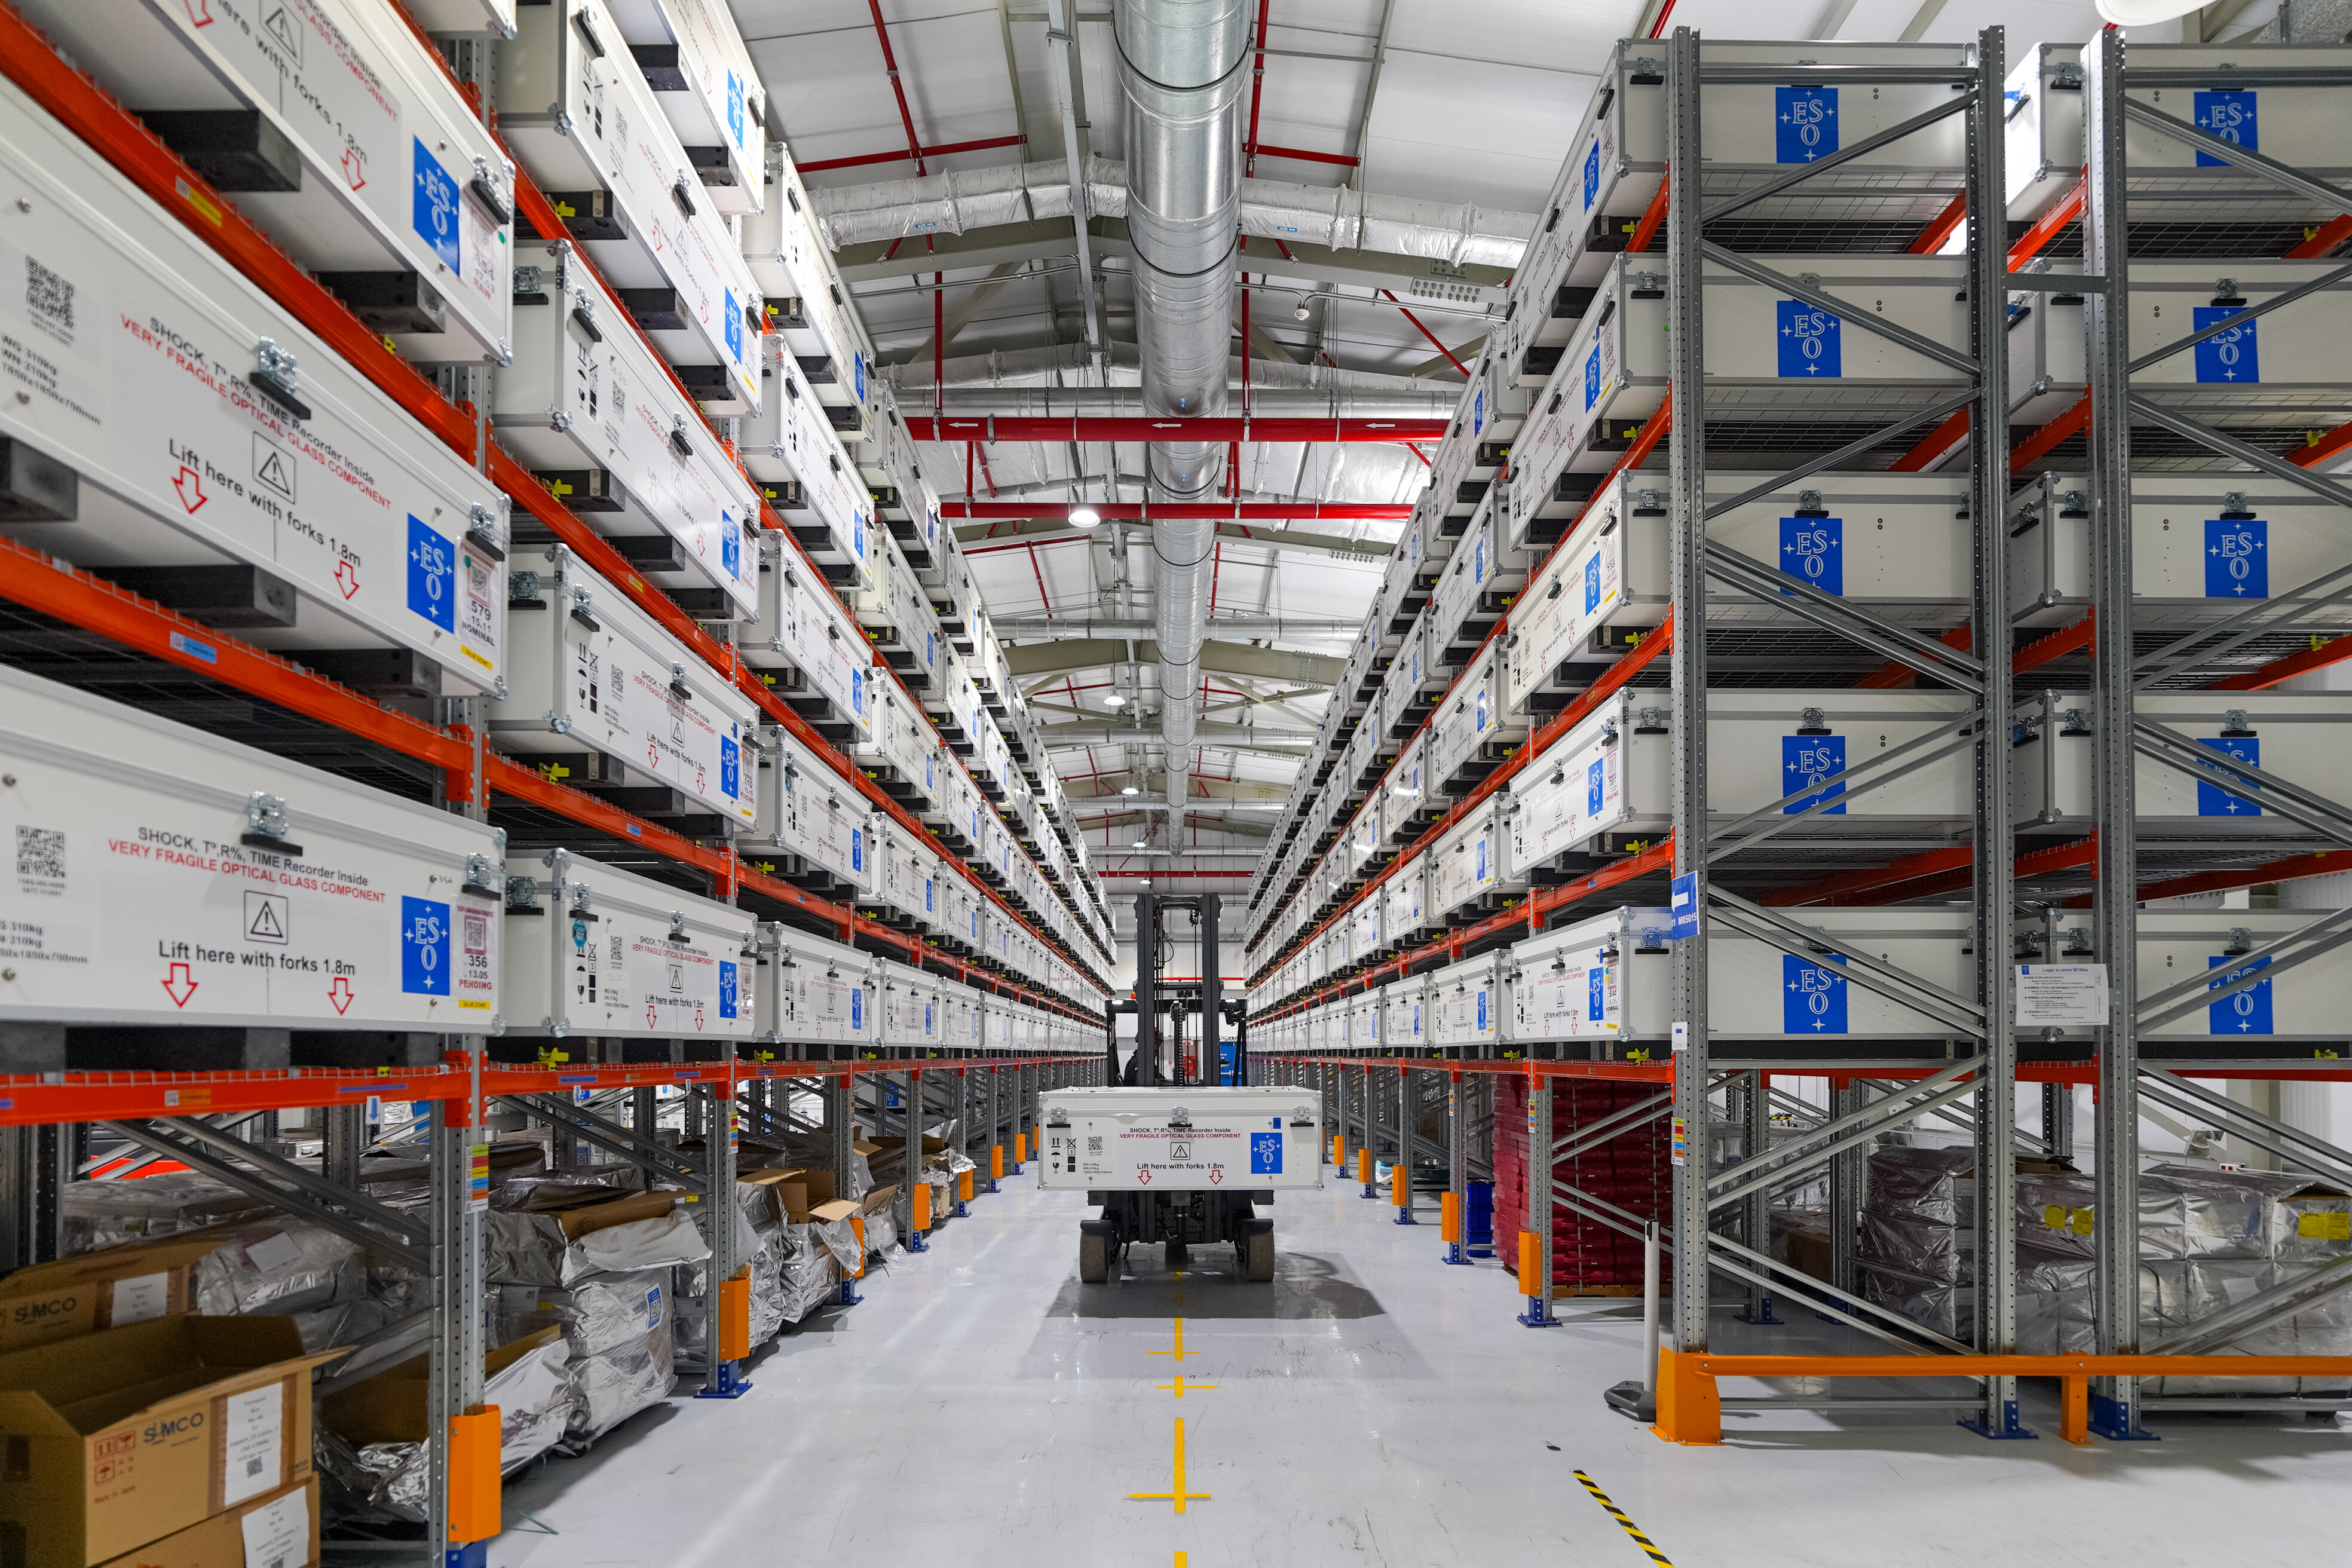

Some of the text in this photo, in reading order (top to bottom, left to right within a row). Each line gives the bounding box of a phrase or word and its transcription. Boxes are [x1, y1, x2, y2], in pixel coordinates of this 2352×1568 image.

[350, 47, 382, 90] Inside
[334, 44, 398, 121] COMPONENT
[255, 35, 368, 164] with forks 1.8m
[1792, 100, 1823, 124] ES
[2212, 103, 2241, 127] ES
[1800, 124, 1819, 145] O
[1794, 313, 1825, 337] ES
[1803, 337, 1821, 359] O
[2219, 343, 2239, 365] O
[121, 314, 161, 351] VERY
[167, 347, 227, 398] FRAGILE
[231, 391, 284, 437] OPTICAL
[287, 432, 324, 466] GLASS
[328, 460, 391, 510] COMPONENT
[150, 317, 208, 370] SHOCK,
[259, 393, 288, 425] TIME
[292, 417, 342, 463] Recorder
[344, 455, 375, 486] Inside
[169, 439, 360, 567] Lift here with forks 1.8m
[1796, 530, 1827, 555] ES
[2222, 532, 2252, 556] ES
[419, 540, 445, 576] ES
[1805, 555, 1823, 577] O
[2230, 558, 2249, 578] O
[426, 573, 442, 601] O
[471, 601, 491, 621] 579
[461, 622, 495, 647] NOMINAL
[633, 674, 715, 736] VERY FRAGILE OPTICAL GLASS COMPONENT
[699, 710, 710, 724] Inside
[647, 731, 706, 774] Lift here with forks 1.8m
[1799, 748, 1830, 773] ES
[740, 792, 754, 803] PENDING
[1606, 791, 1619, 802] PENDING
[138, 826, 197, 853] SHOCK,
[250, 851, 280, 868] TIME
[284, 858, 335, 879] Recorder
[338, 870, 368, 887] Inside
[108, 838, 385, 903] VERY FRAGILE OPTICAL GLASS COMPONENT
[414, 917, 440, 945] ES
[1678, 913, 1696, 925] M05015
[159, 941, 355, 975] Lift here with forks 1.8m
[421, 945, 437, 970] O
[468, 955, 487, 968] 356
[632, 944, 714, 966] VERY FRAGILE OPTICAL GLASS COMPONENT
[681, 945, 697, 955] Recorder
[459, 979, 492, 990] PENDING
[468, 970, 488, 979] 13.05
[1800, 968, 1832, 992] ES
[645, 994, 704, 1009] Lift here with forks 1.8m
[1809, 992, 1828, 1014] O
[2235, 994, 2253, 1015] O
[1259, 1140, 1275, 1153] ES
[1263, 1152, 1273, 1164] O
